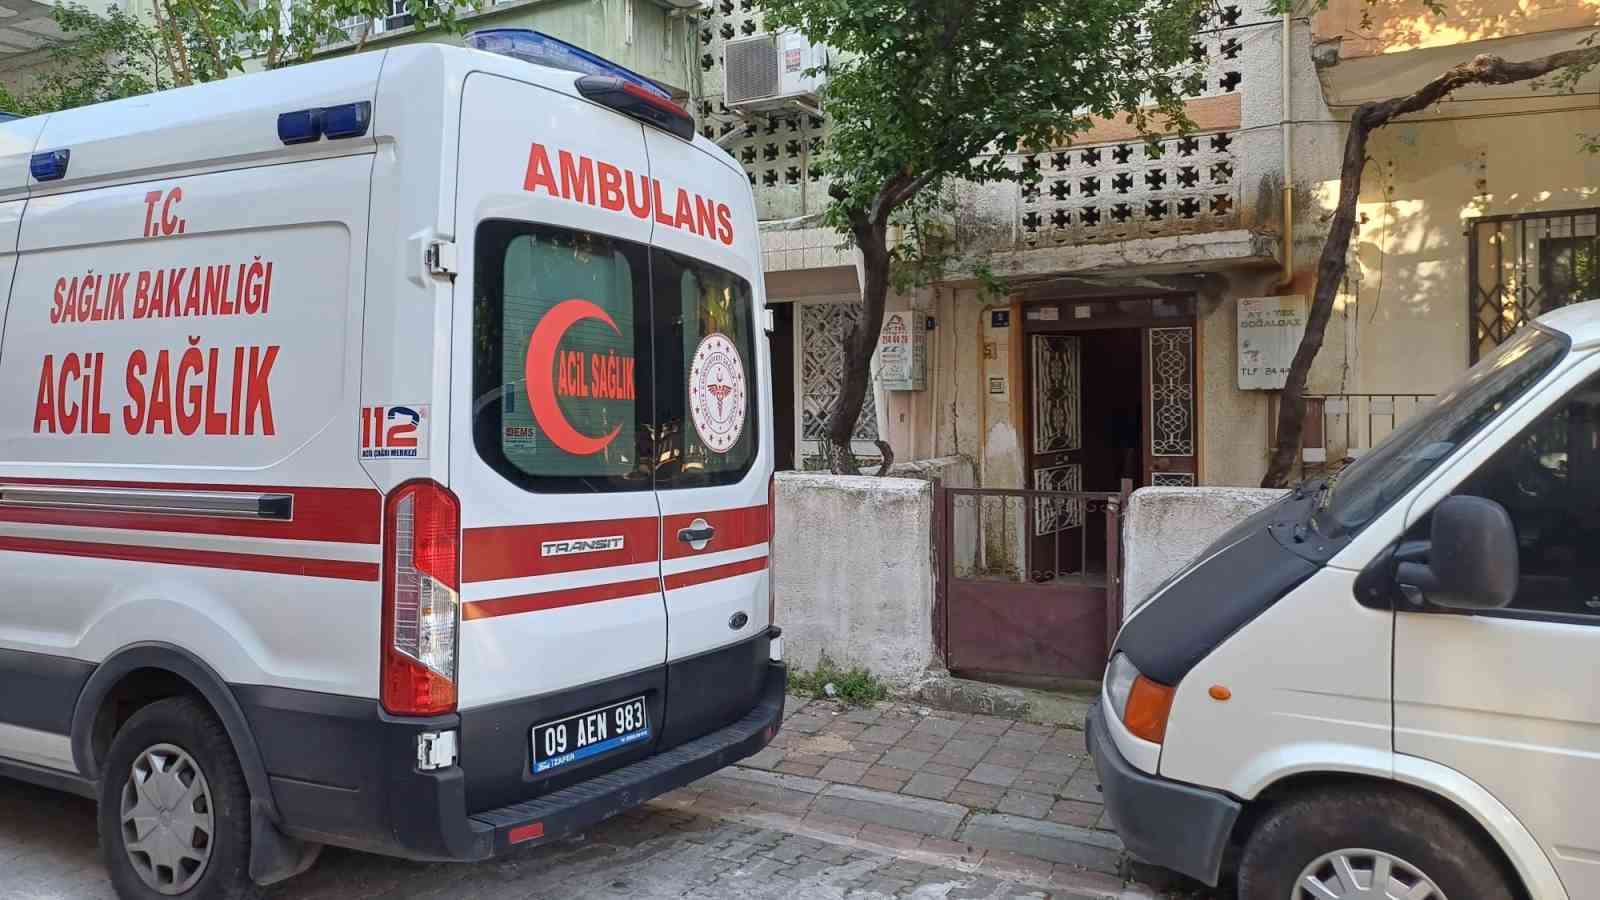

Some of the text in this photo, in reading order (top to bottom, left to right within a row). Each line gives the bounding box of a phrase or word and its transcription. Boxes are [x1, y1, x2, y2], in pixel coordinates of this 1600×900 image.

[143, 187, 186, 237] T.C.
[524, 142, 734, 246] AMBULANS
[50, 256, 273, 324] SAĞLIK BAKANLIĞI
[123, 335, 280, 436] SAĞLIK
[592, 348, 635, 401] SAĞLIK
[362, 406, 420, 448] 112
[543, 537, 623, 554] TRANSIT
[545, 724, 567, 756] 09
[577, 711, 608, 748] AEN
[615, 702, 643, 734] 983
